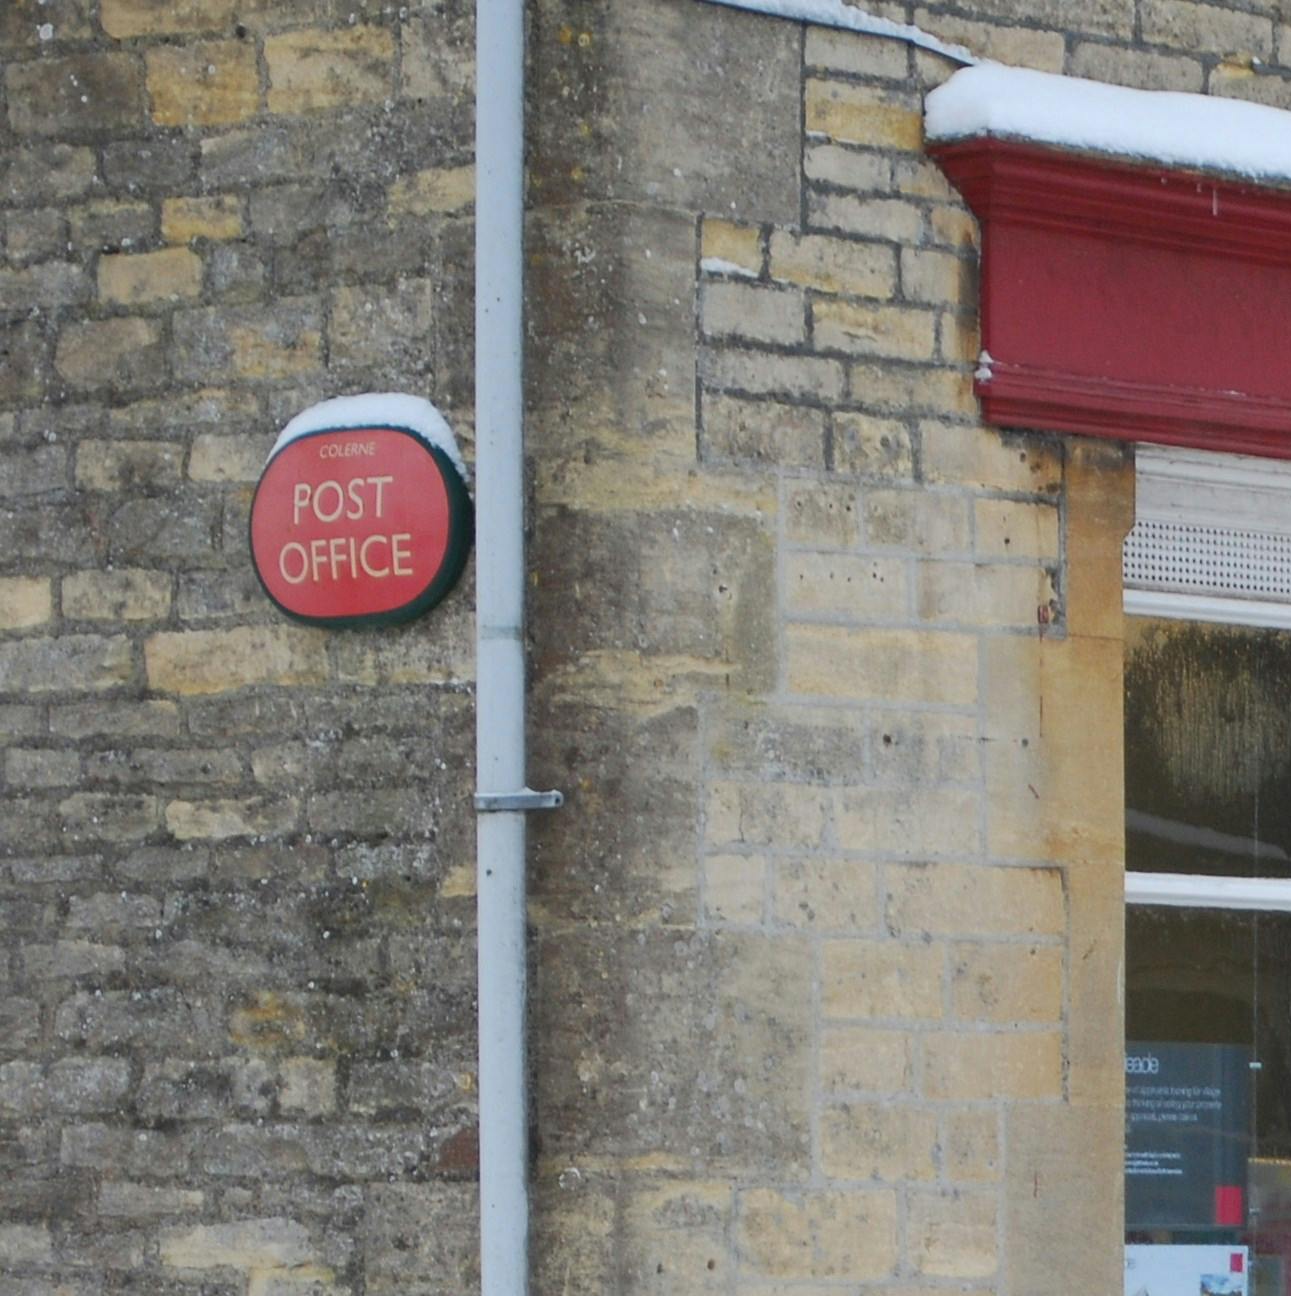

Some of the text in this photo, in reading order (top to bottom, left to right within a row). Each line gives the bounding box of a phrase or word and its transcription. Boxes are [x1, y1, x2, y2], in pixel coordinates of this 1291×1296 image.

[319, 442, 376, 459] COLERNE
[293, 476, 393, 525] POST
[279, 533, 413, 585] OFFICE
